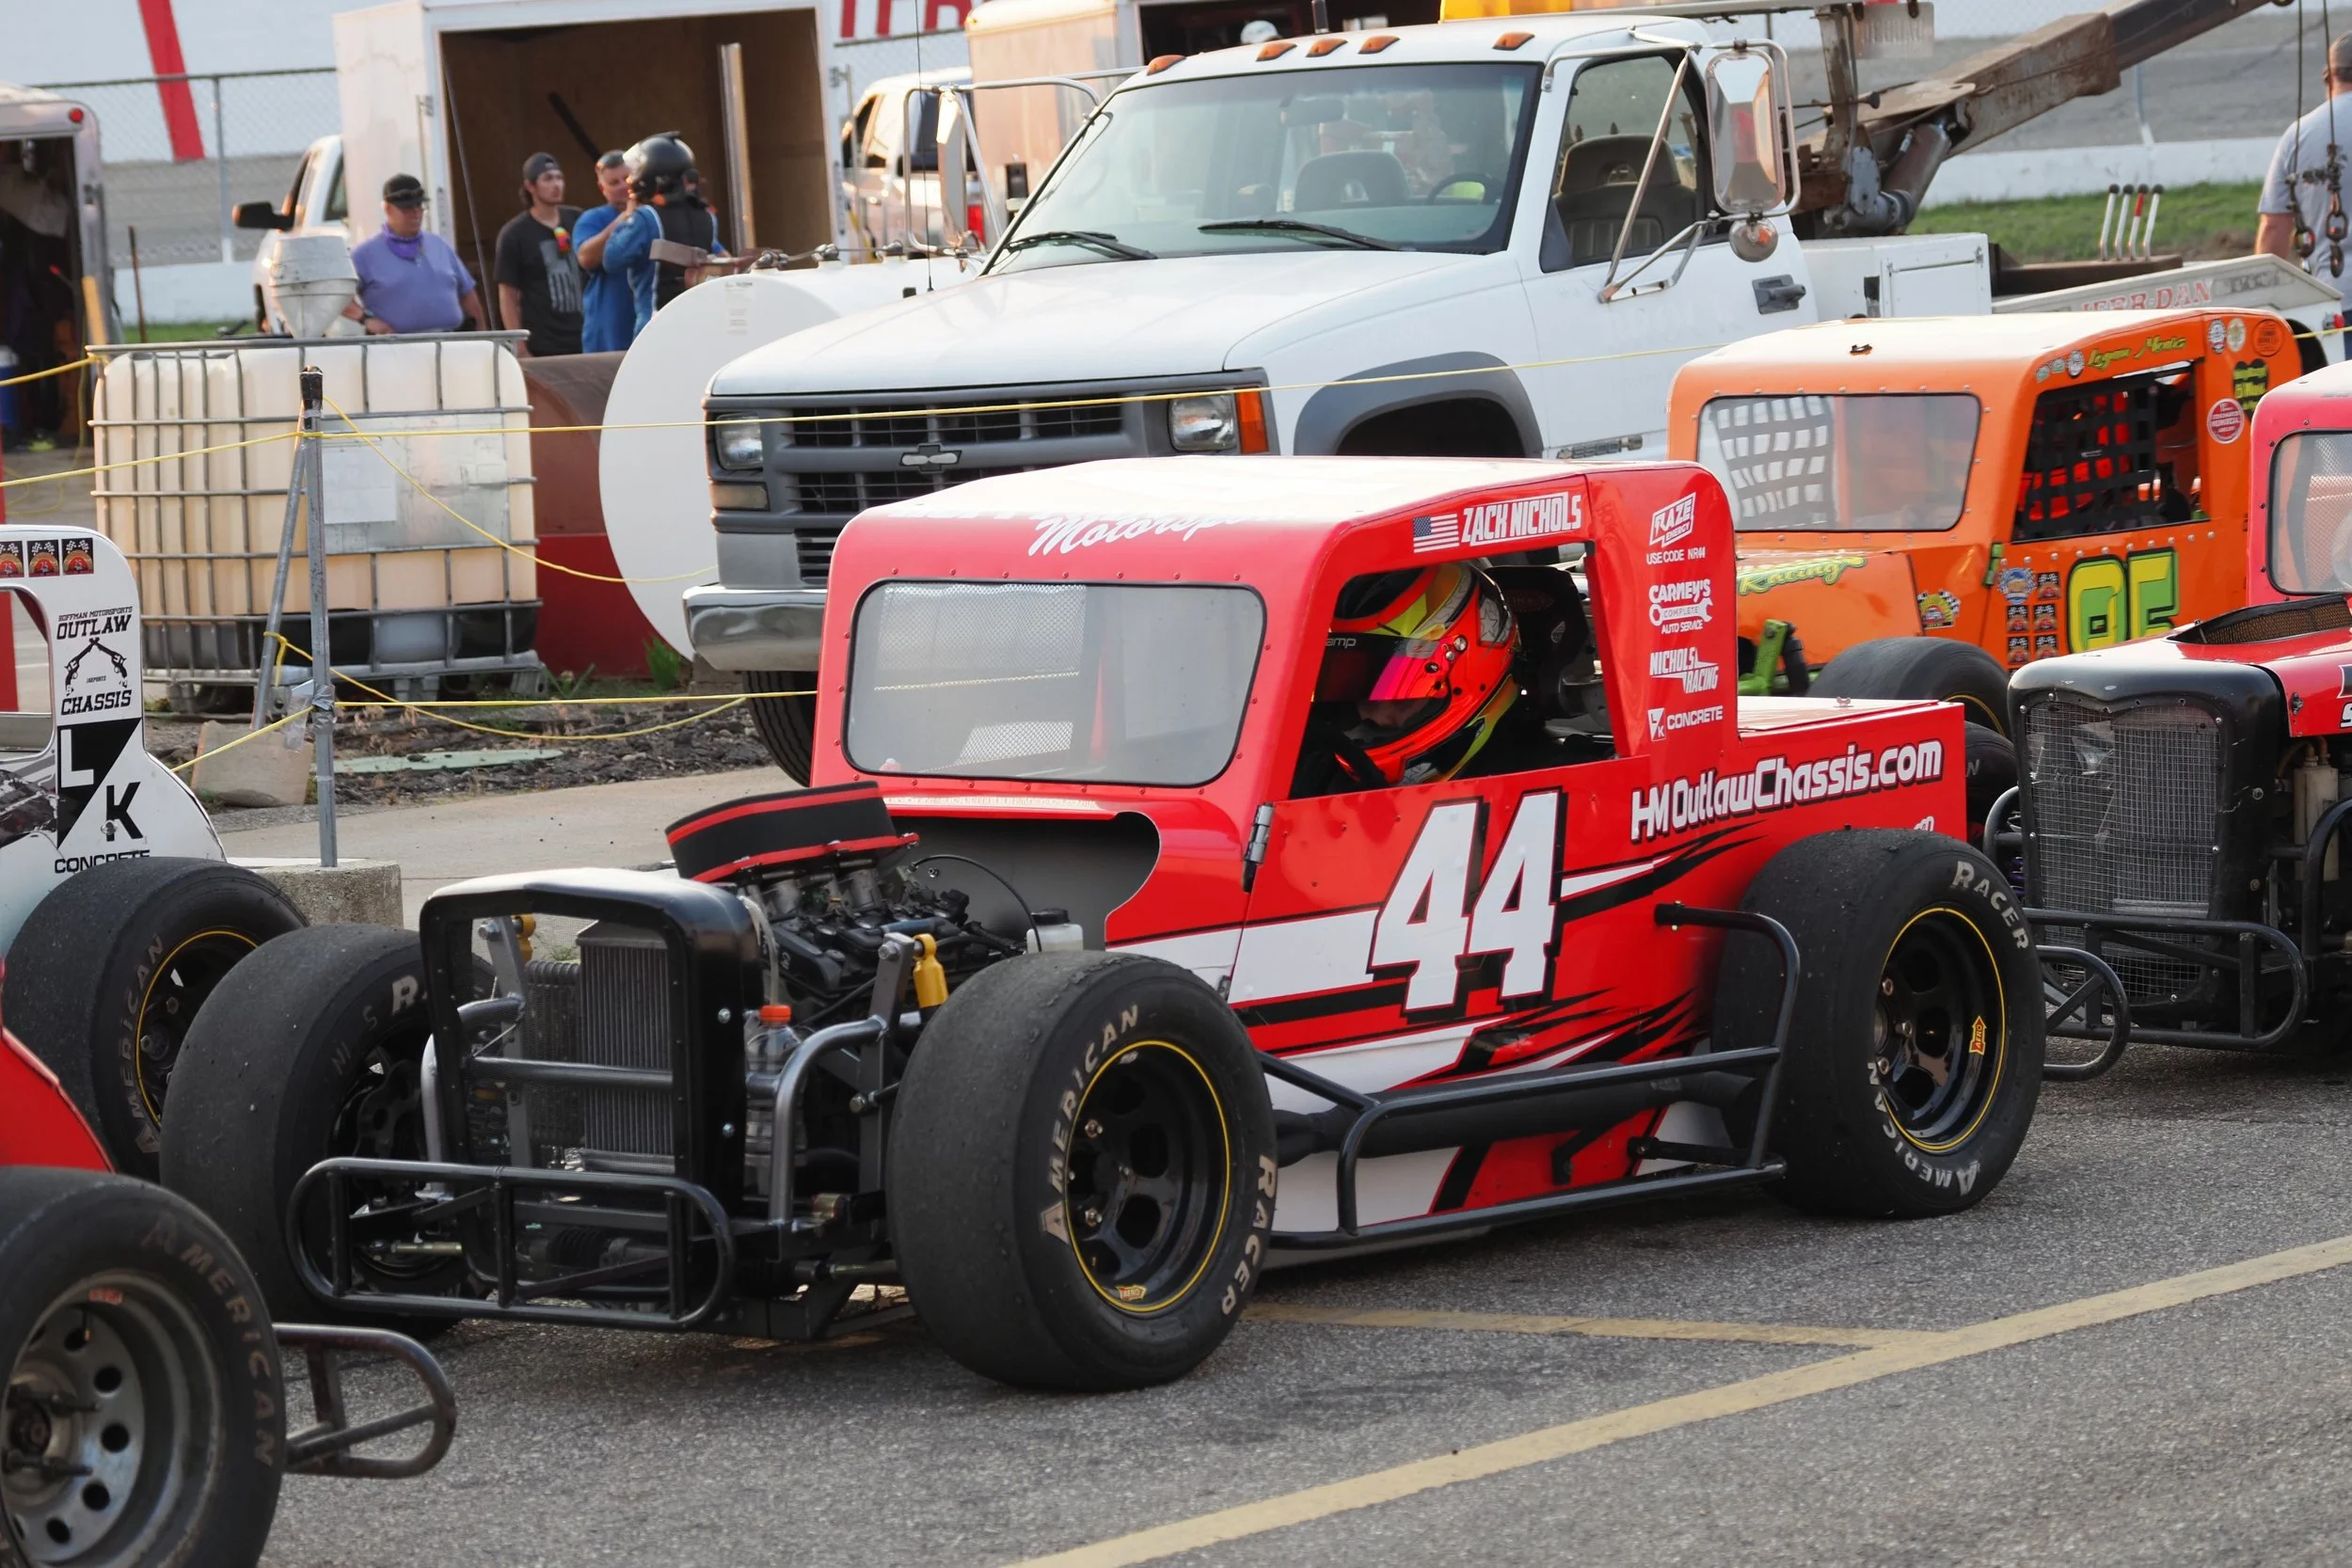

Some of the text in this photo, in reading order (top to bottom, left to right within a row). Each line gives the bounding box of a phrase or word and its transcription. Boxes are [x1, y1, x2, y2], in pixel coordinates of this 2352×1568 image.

[1461, 502, 1509, 546] ZACK
[1510, 491, 1581, 537] NICHOLS
[1654, 498, 1692, 537] RAZE
[1646, 551, 1663, 564] USE
[1663, 548, 1685, 562] CODE
[1648, 578, 1711, 604] CARNEY'S
[56, 614, 132, 641] OUTLAW
[58, 606, 134, 622] HOFFMAN MOTORSPORTS
[1661, 619, 1703, 635] AUTO SERVICE
[1663, 605, 1699, 619] COMPLETE
[1325, 637, 1357, 649] amp
[1649, 646, 1697, 676] NICHOLS
[1685, 666, 1720, 694] RACING
[61, 689, 132, 716] CHASSIS
[1667, 705, 1724, 730] CONCRETE
[60, 729, 94, 788] L
[106, 782, 144, 842] K
[1370, 791, 1562, 1012] 44
[1950, 861, 2029, 949] RACER
[119, 933, 164, 1153] AMERICAN
[1041, 1004, 1138, 1245] AMERICAN
[1867, 1062, 1981, 1197] AMERICAN
[1222, 1154, 1279, 1316] RACER
[141, 1211, 276, 1467] AMERICAN
